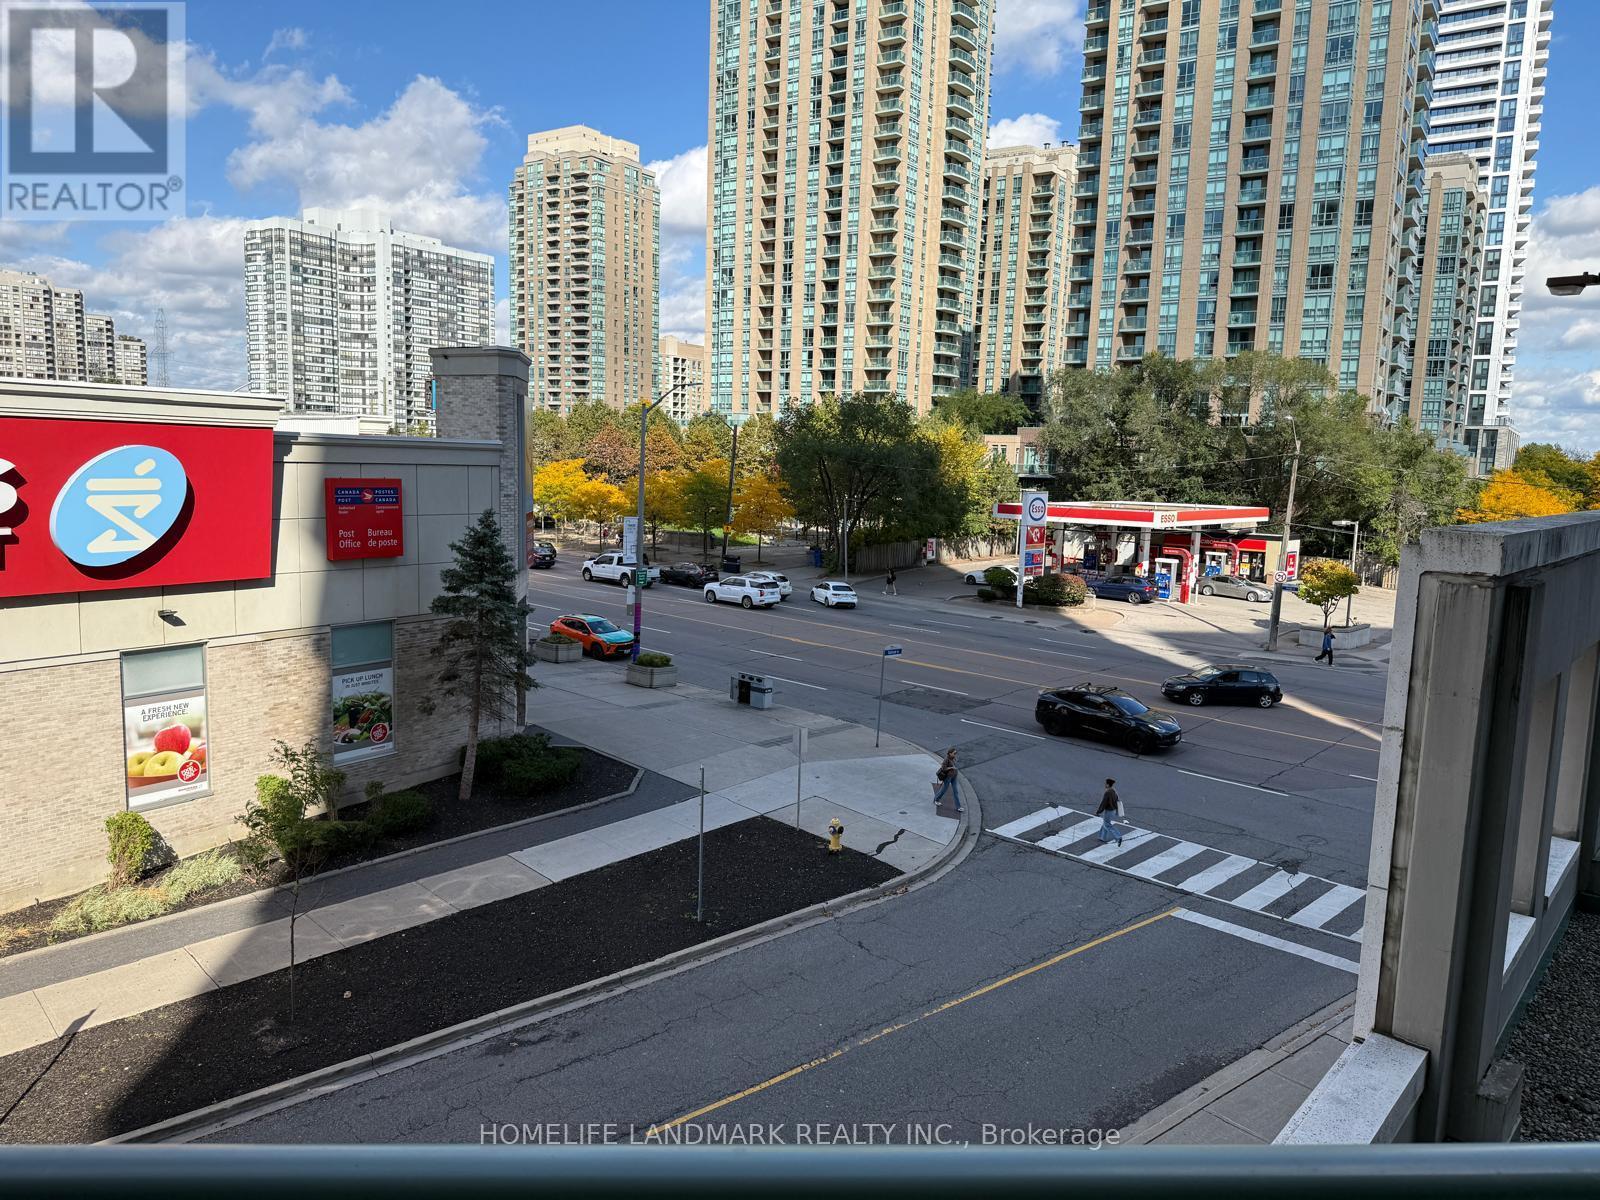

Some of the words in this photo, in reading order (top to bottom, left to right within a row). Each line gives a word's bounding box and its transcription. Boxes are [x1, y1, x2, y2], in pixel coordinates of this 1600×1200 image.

[338, 529, 355, 538] Post
[367, 528, 393, 537] Bureau
[338, 540, 361, 549] Office
[368, 538, 377, 547] de
[378, 539, 398, 549] poste
[364, 672, 384, 681] LUNCH
[148, 705, 172, 714] FRESH
[174, 702, 190, 710] NEW
